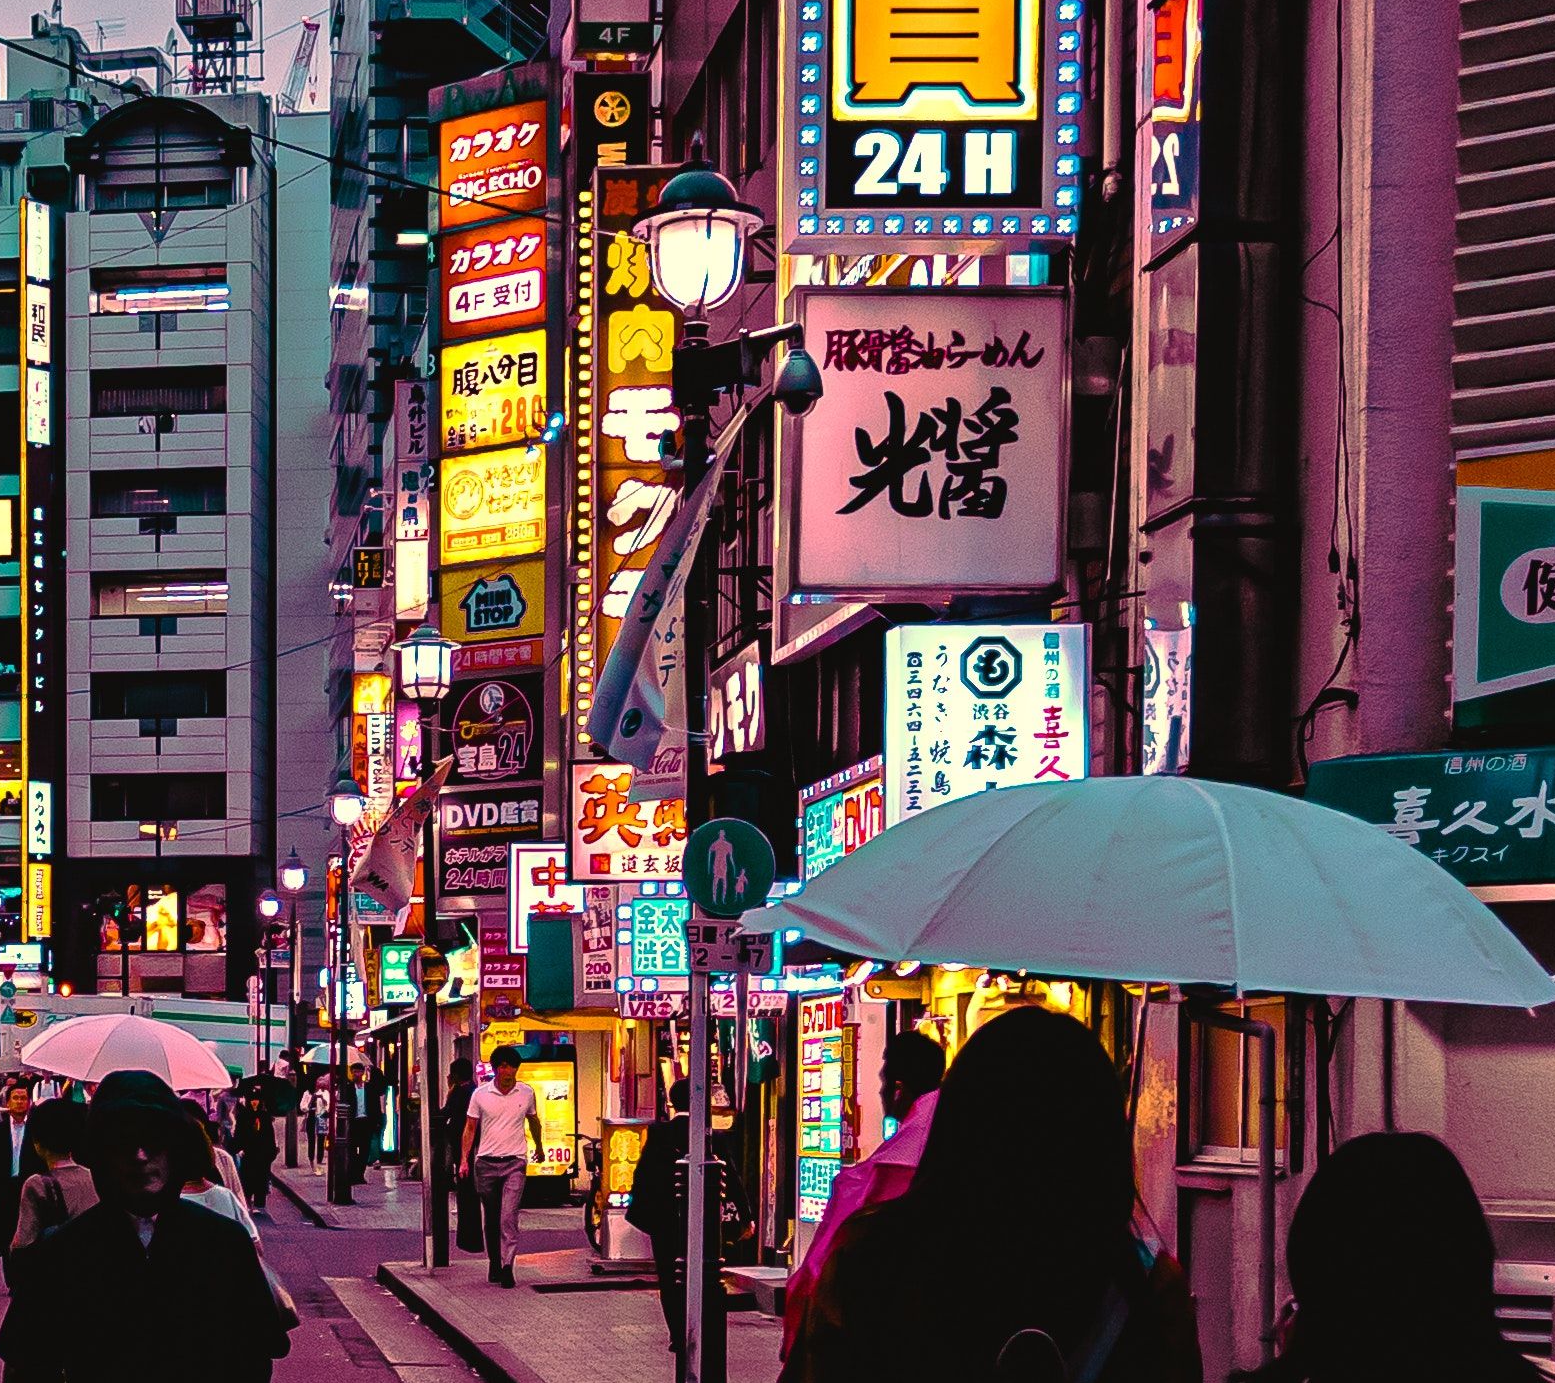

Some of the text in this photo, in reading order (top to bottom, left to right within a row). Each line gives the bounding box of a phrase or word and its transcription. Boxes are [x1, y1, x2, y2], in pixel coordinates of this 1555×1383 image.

[598, 26, 631, 44] 4F
[449, 122, 540, 163] カラオケ
[449, 166, 542, 207] BIG ECHO
[449, 235, 541, 274] カラオケ
[456, 280, 531, 313] 4F 受付
[32, 302, 48, 345] 和民
[452, 352, 538, 397] 腹八分目
[472, 602, 514, 625] STOP
[452, 645, 532, 672] 24時間営業
[1042, 632, 1061, 699] 信州の酒
[973, 703, 1010, 721] 渋谷
[457, 732, 527, 774] 宝島24
[963, 726, 1018, 792] 森
[1033, 706, 1070, 781] 喜久
[929, 740, 952, 796] 焼鳥
[1444, 751, 1528, 776] 信州の酒
[447, 800, 538, 828] DVD鑑賞
[445, 868, 507, 890] 24時間
[485, 963, 520, 971] カラオケ
[585, 962, 612, 975] 200
[636, 940, 682, 969] 渋谷
